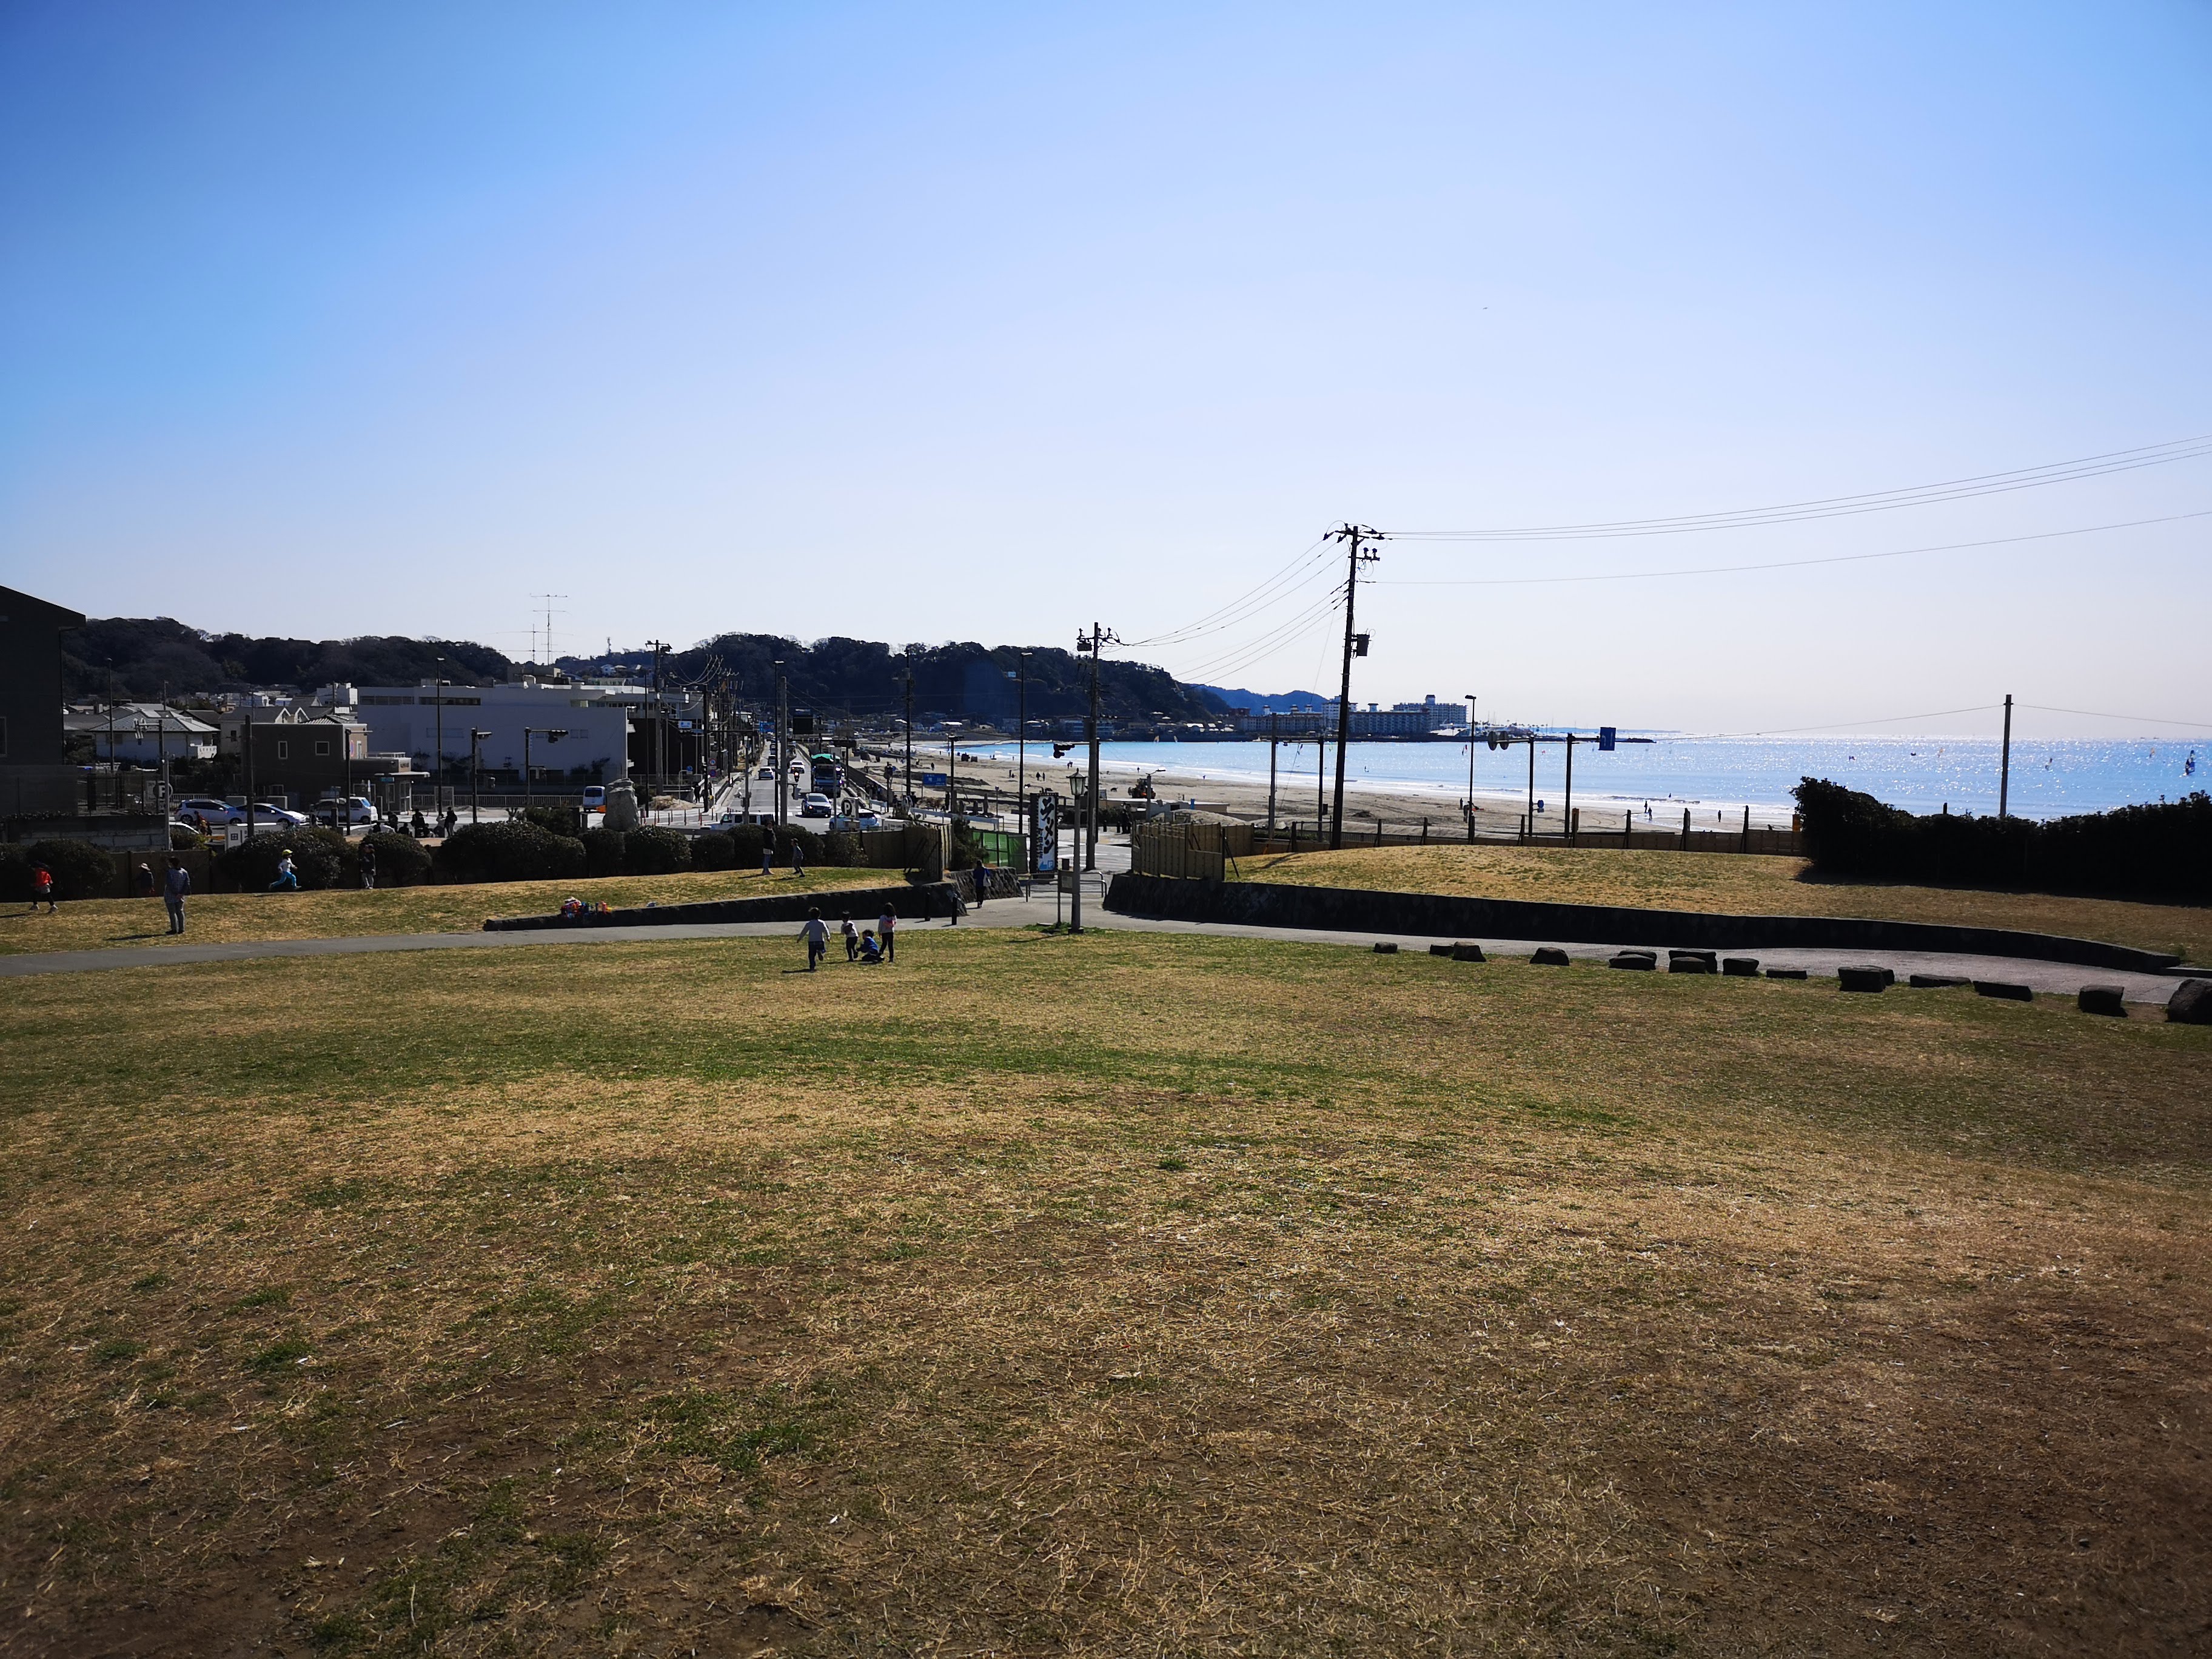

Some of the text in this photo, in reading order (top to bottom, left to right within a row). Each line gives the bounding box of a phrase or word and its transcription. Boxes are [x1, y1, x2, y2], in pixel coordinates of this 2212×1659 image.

[844, 802, 850, 814] P
[1040, 797, 1054, 854] ラーメン
